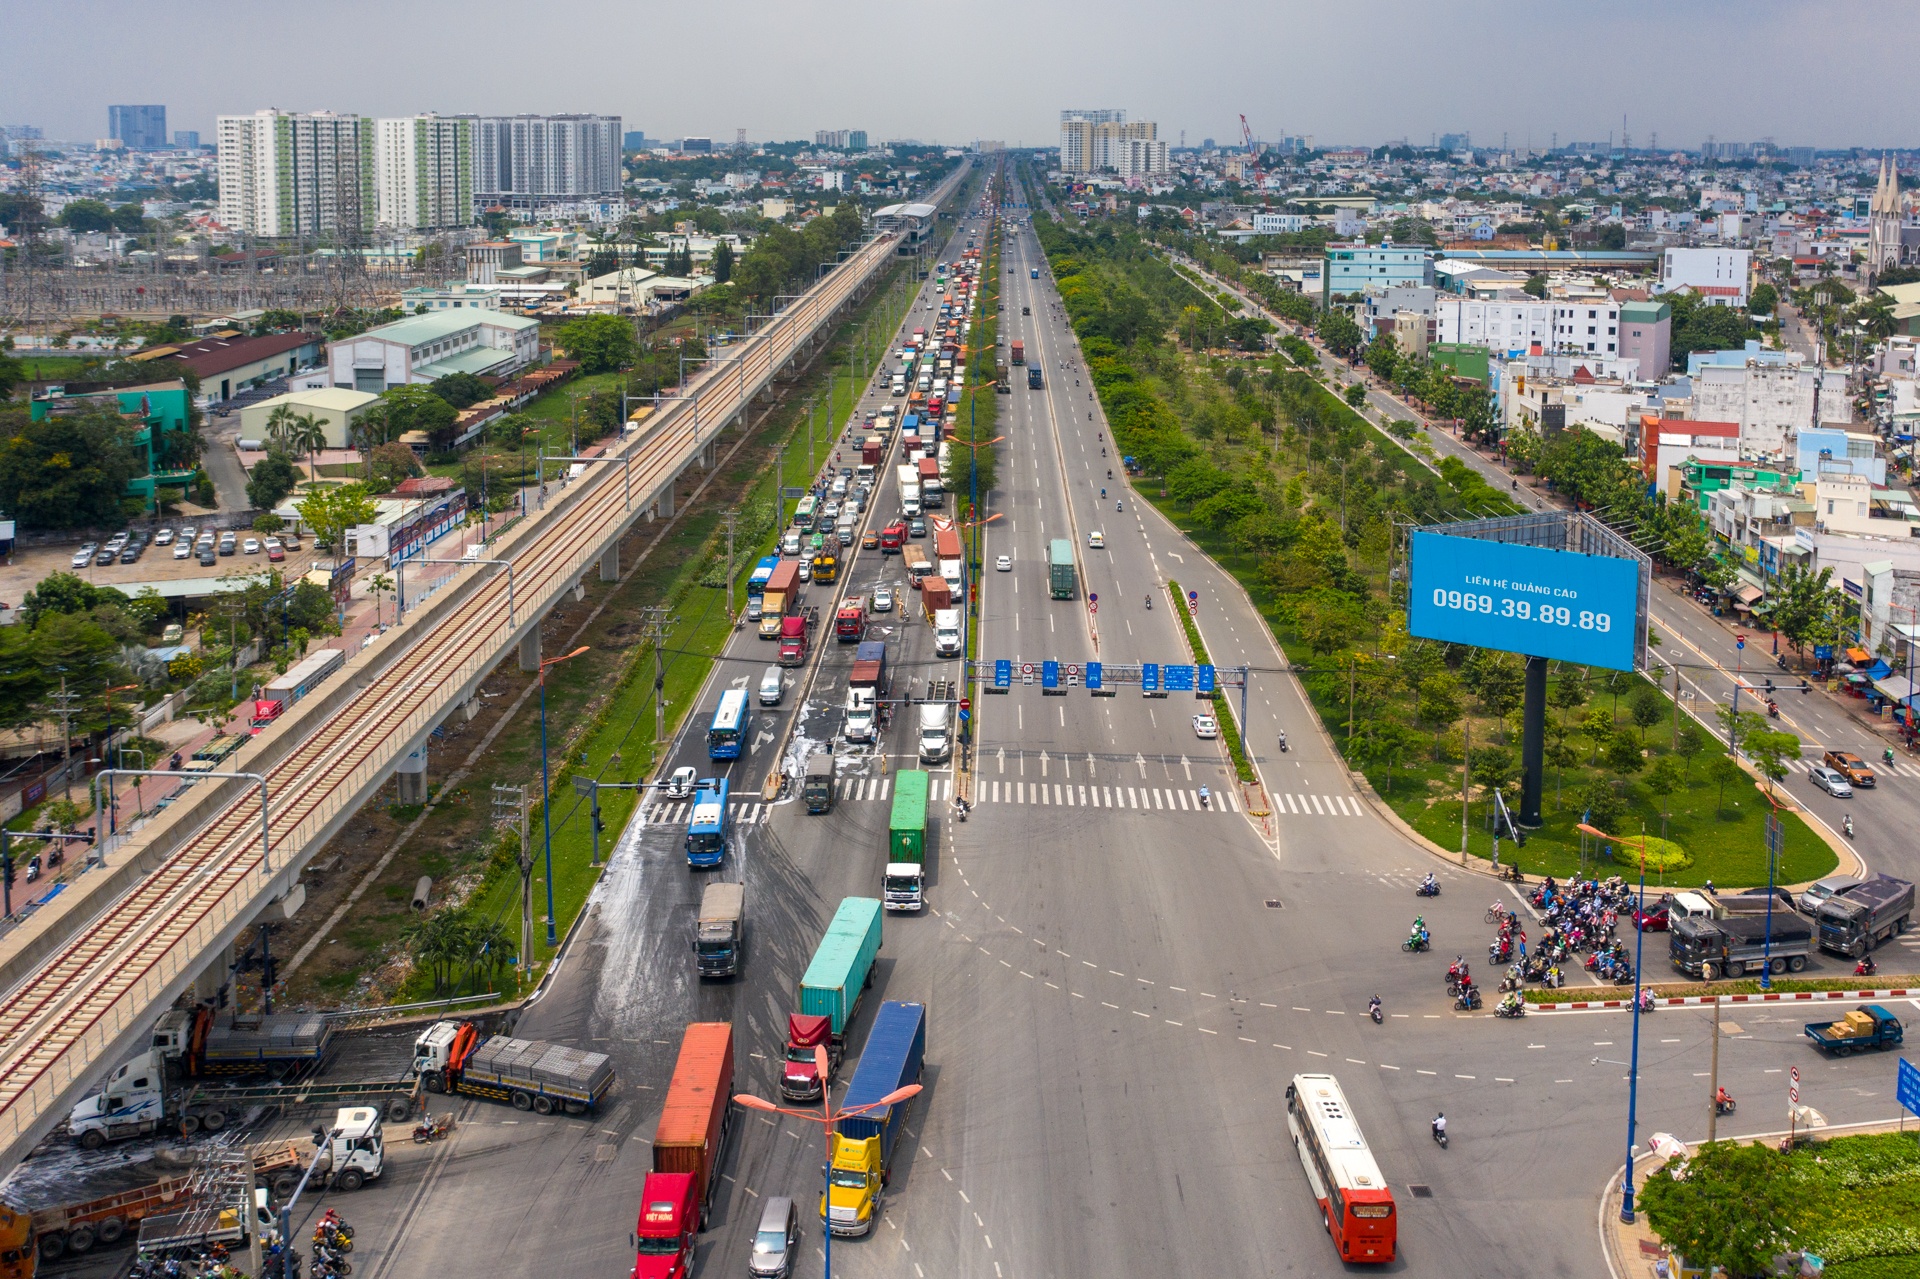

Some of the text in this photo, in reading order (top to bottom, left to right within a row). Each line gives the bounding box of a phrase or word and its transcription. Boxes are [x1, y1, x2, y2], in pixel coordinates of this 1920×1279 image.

[1465, 575, 1578, 599] LIÊN HỆ QUẢNG CÁO
[1433, 588, 1611, 633] 0969.39.89.89
